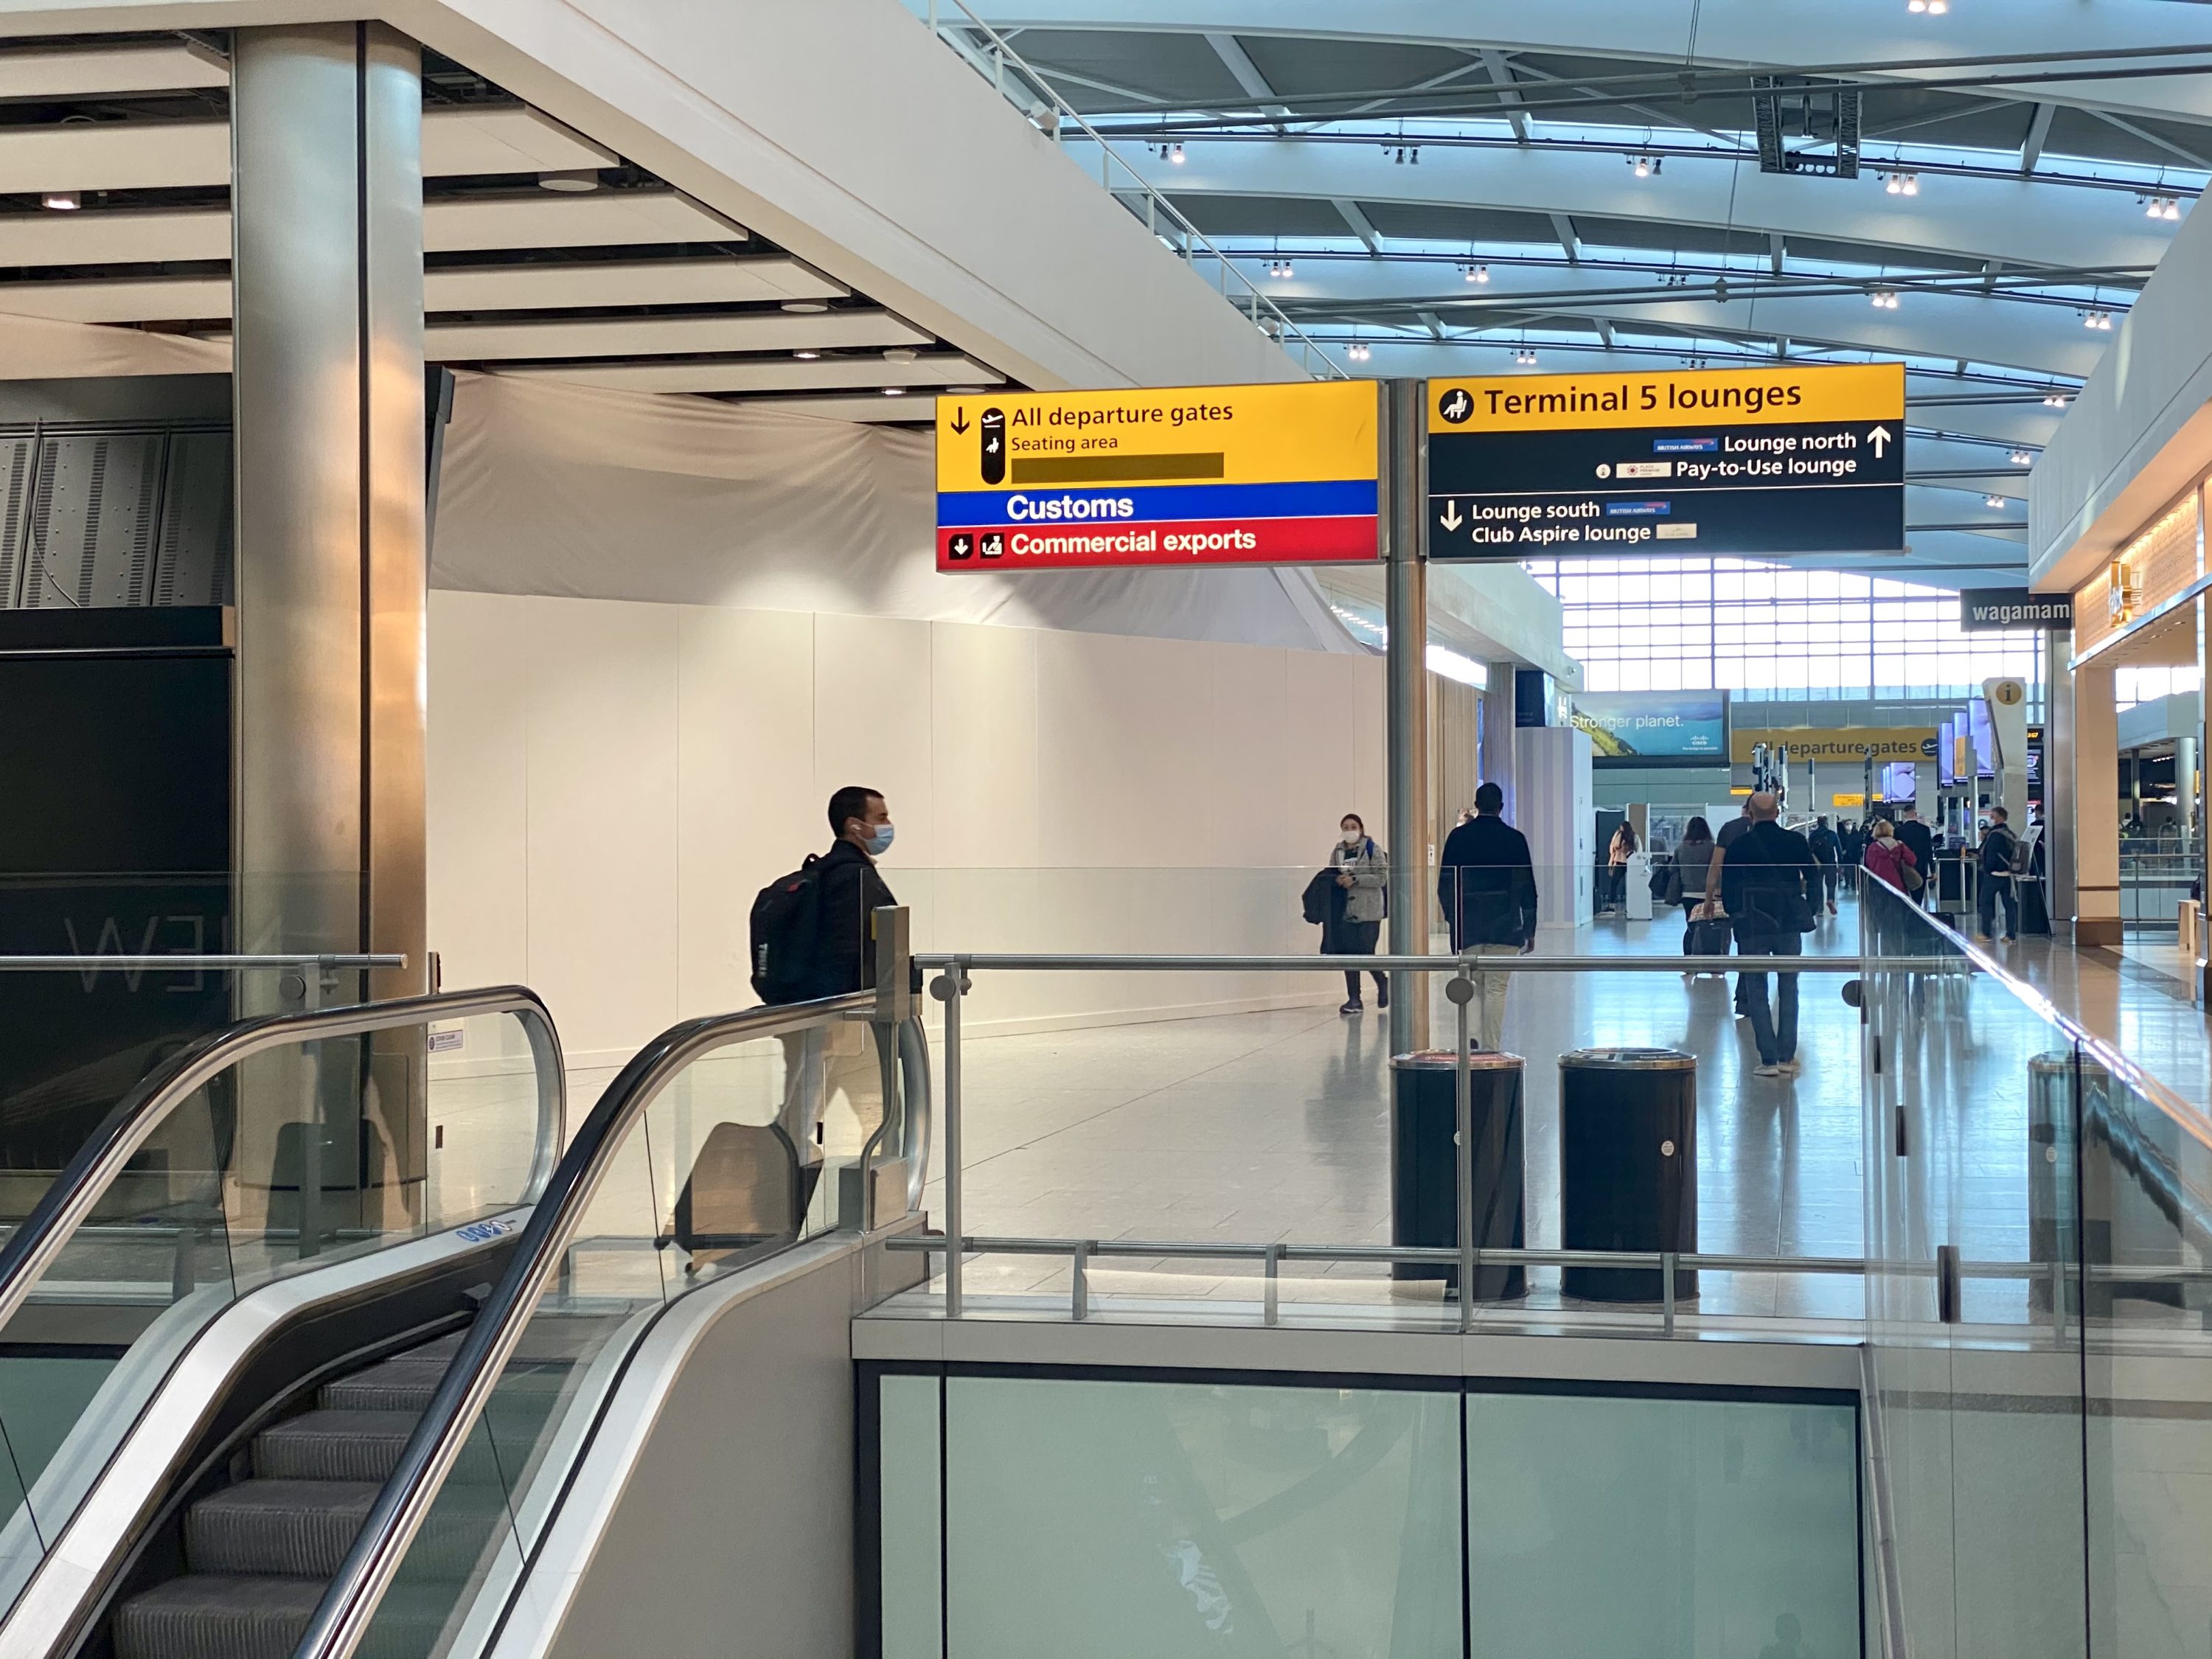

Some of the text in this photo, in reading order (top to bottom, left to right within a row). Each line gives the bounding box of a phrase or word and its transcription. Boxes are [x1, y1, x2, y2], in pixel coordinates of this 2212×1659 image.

[1484, 382, 1802, 415] Terminal 5 lounges
[1012, 403, 1234, 430] All departure gates
[1011, 436, 1119, 454] Seating area
[1724, 431, 1857, 456] Lounge north
[1677, 456, 1857, 481] Pay-to-Use lounge
[1006, 493, 1134, 521] Customs
[1472, 501, 1600, 523] Lounge south
[1011, 529, 1256, 555] Commercial exports
[1472, 524, 1651, 546] Club Aspire lounge
[1571, 714, 1684, 730] Stronger planet.
[1871, 741, 1917, 757] gates
